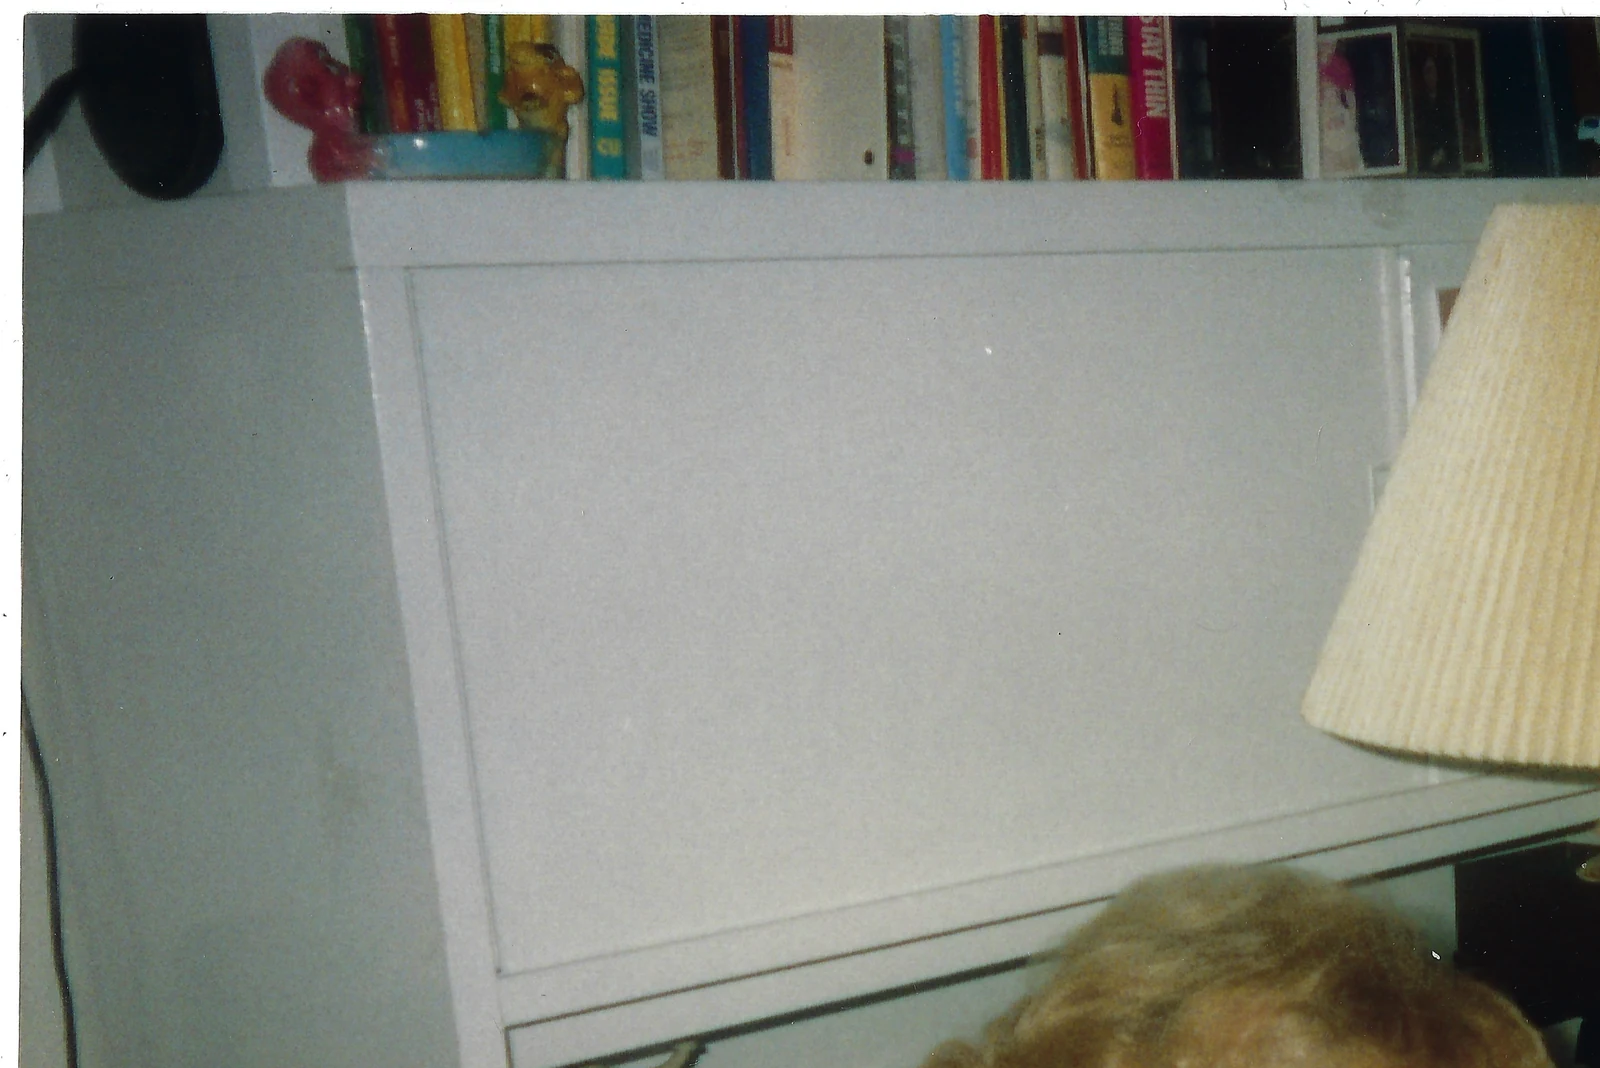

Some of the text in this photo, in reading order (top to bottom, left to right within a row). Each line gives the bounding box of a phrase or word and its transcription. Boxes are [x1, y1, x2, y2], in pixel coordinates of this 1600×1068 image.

[1141, 15, 1167, 119] STAY THIN
[640, 90, 657, 137] SHOW
